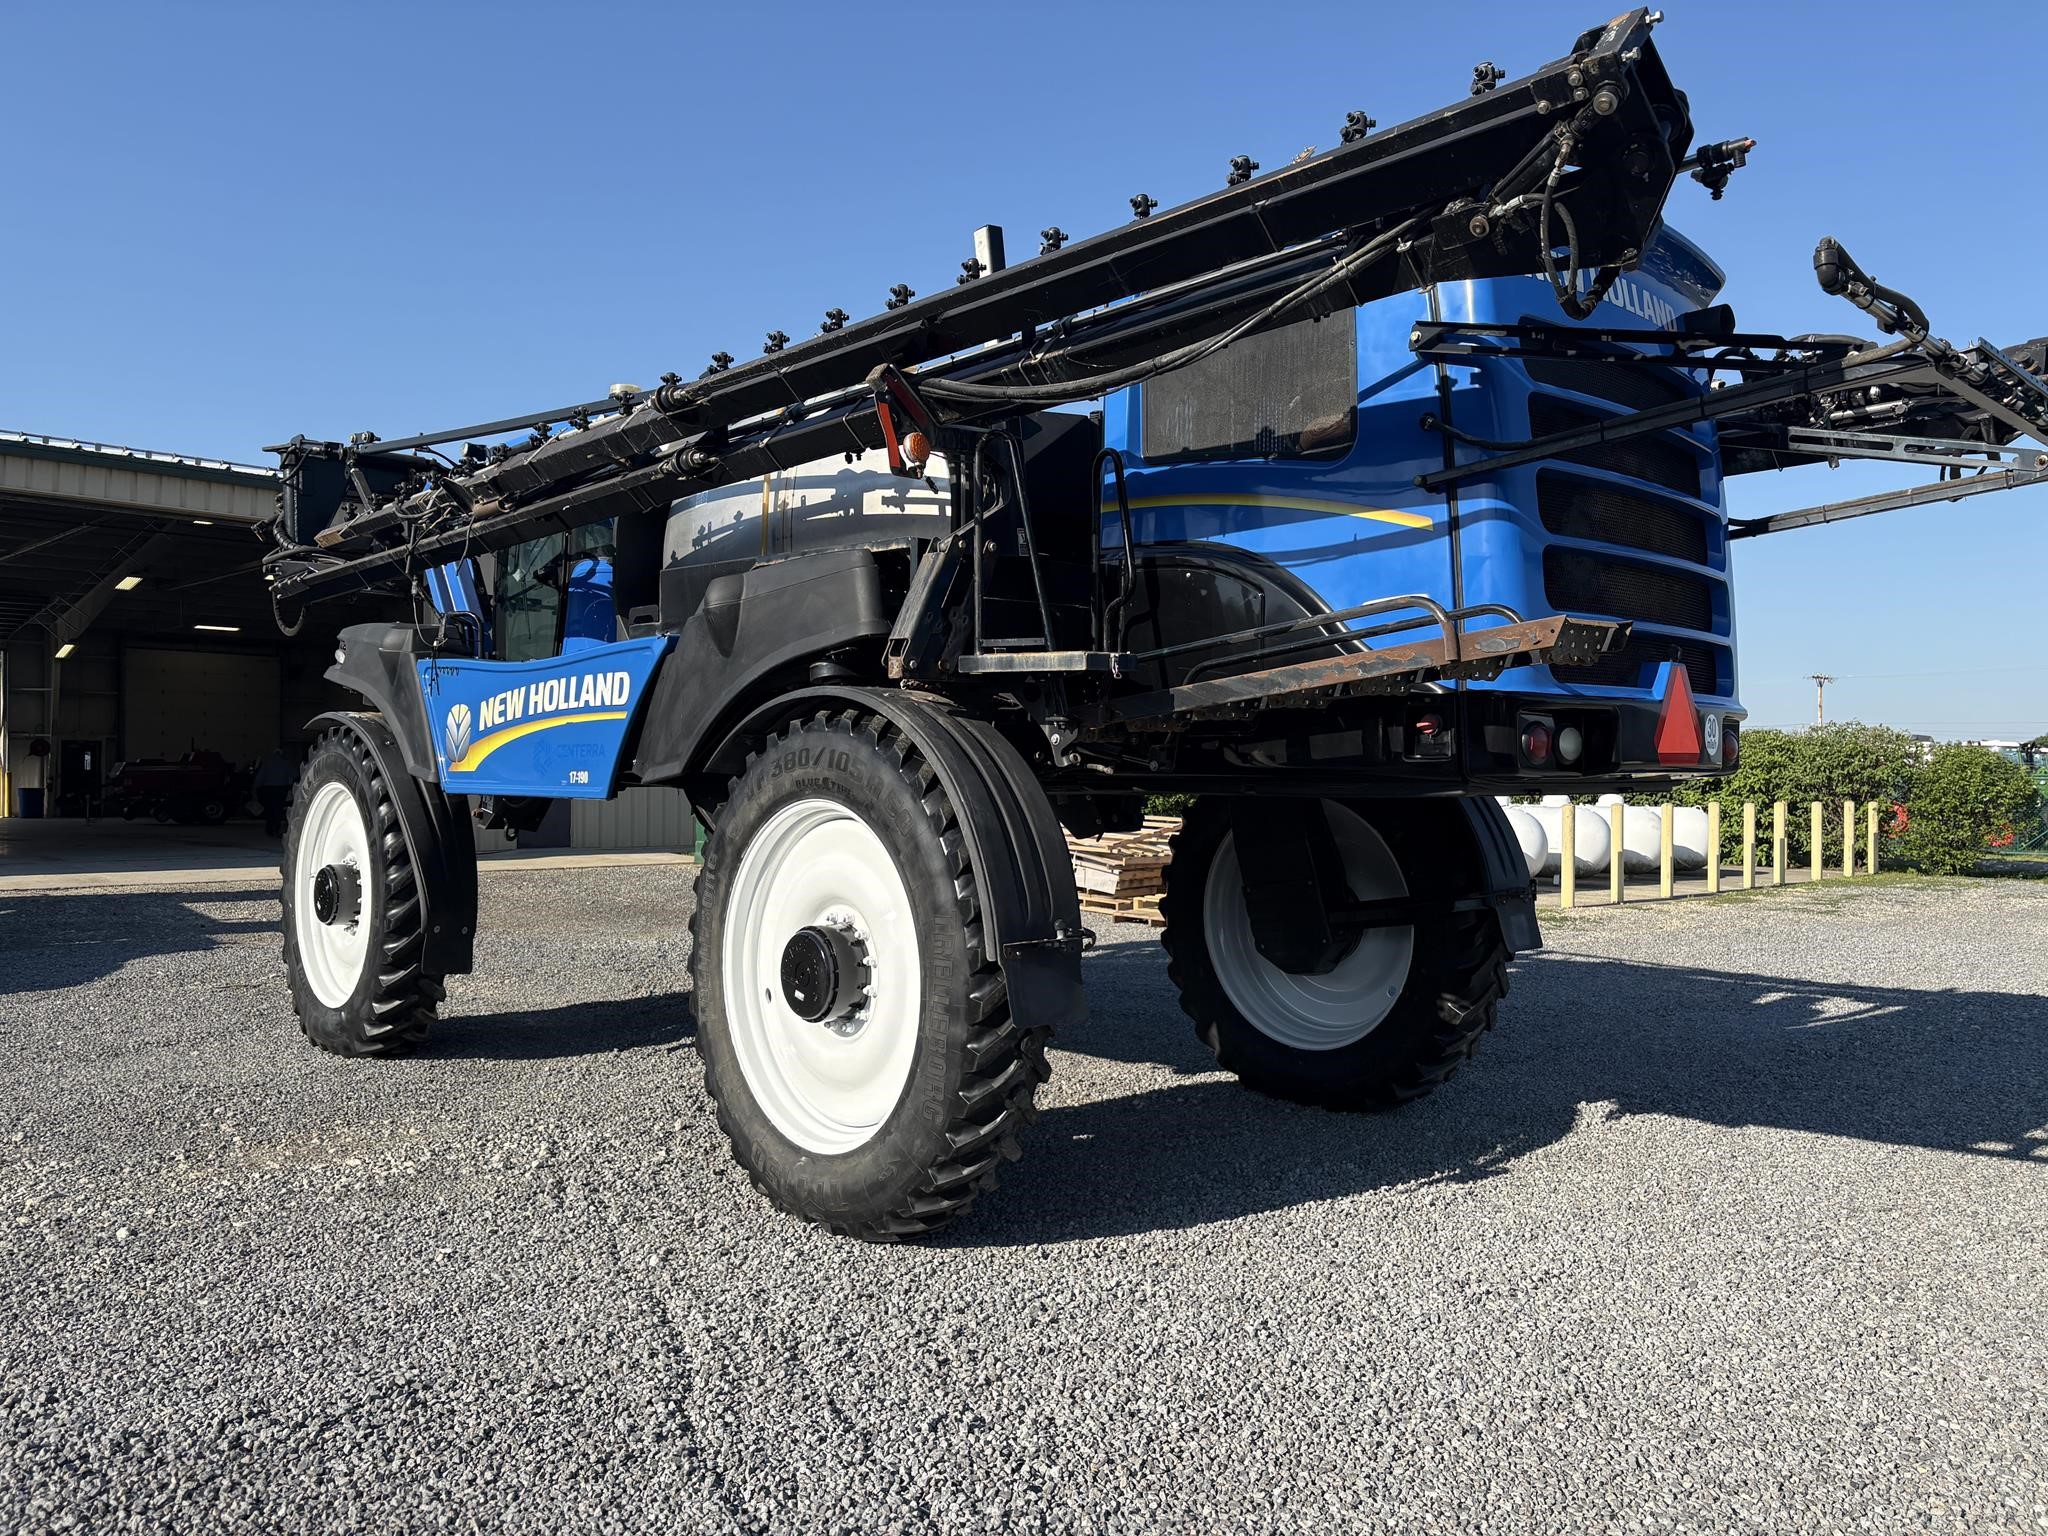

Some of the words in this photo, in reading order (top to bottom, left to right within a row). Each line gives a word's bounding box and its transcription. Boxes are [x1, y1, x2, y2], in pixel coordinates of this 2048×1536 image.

[479, 686, 526, 731] NEW
[528, 671, 631, 716] HOLLAND
[1707, 717, 1717, 738] 30
[922, 908, 958, 1128] TRELLEBORG
